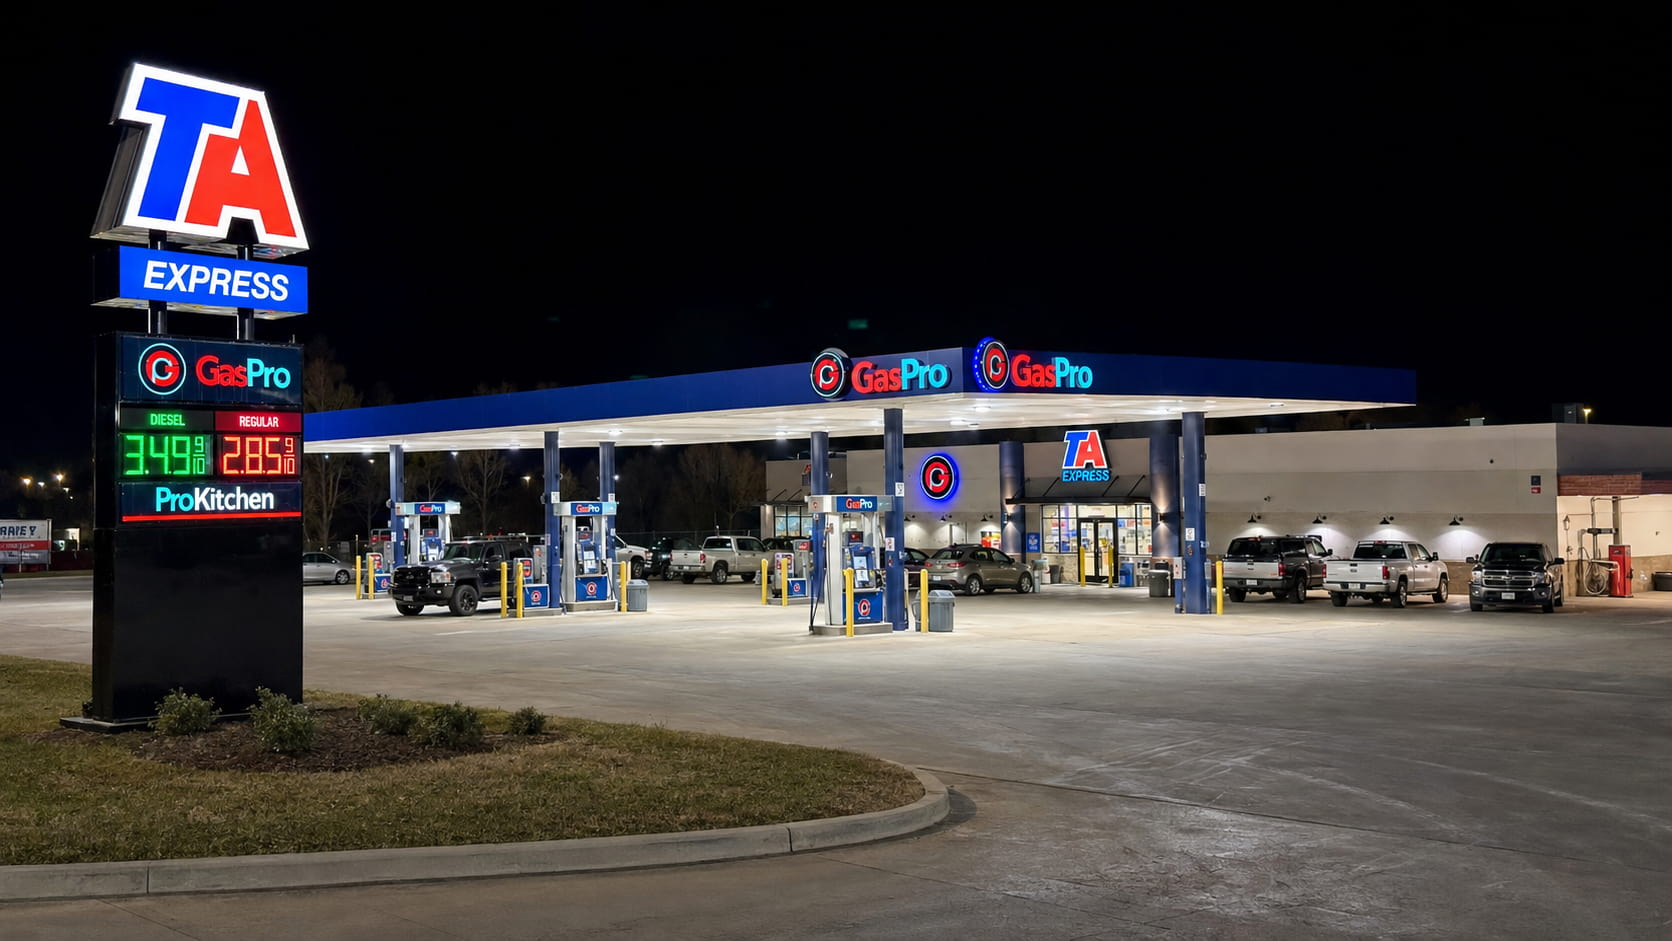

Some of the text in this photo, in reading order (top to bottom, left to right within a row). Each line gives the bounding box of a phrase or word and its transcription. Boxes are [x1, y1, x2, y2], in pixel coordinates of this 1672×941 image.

[120, 64, 308, 249] TA
[143, 259, 289, 301] EXPRESS
[195, 354, 291, 389] GasPro
[851, 358, 948, 394] GasPro
[1011, 353, 1093, 388] GasPro
[150, 413, 186, 426] DIESEL
[239, 415, 280, 428] REGULAR
[1062, 430, 1107, 469] TA
[1062, 469, 1110, 482] EXPRESS
[155, 486, 275, 512] ProKitchen
